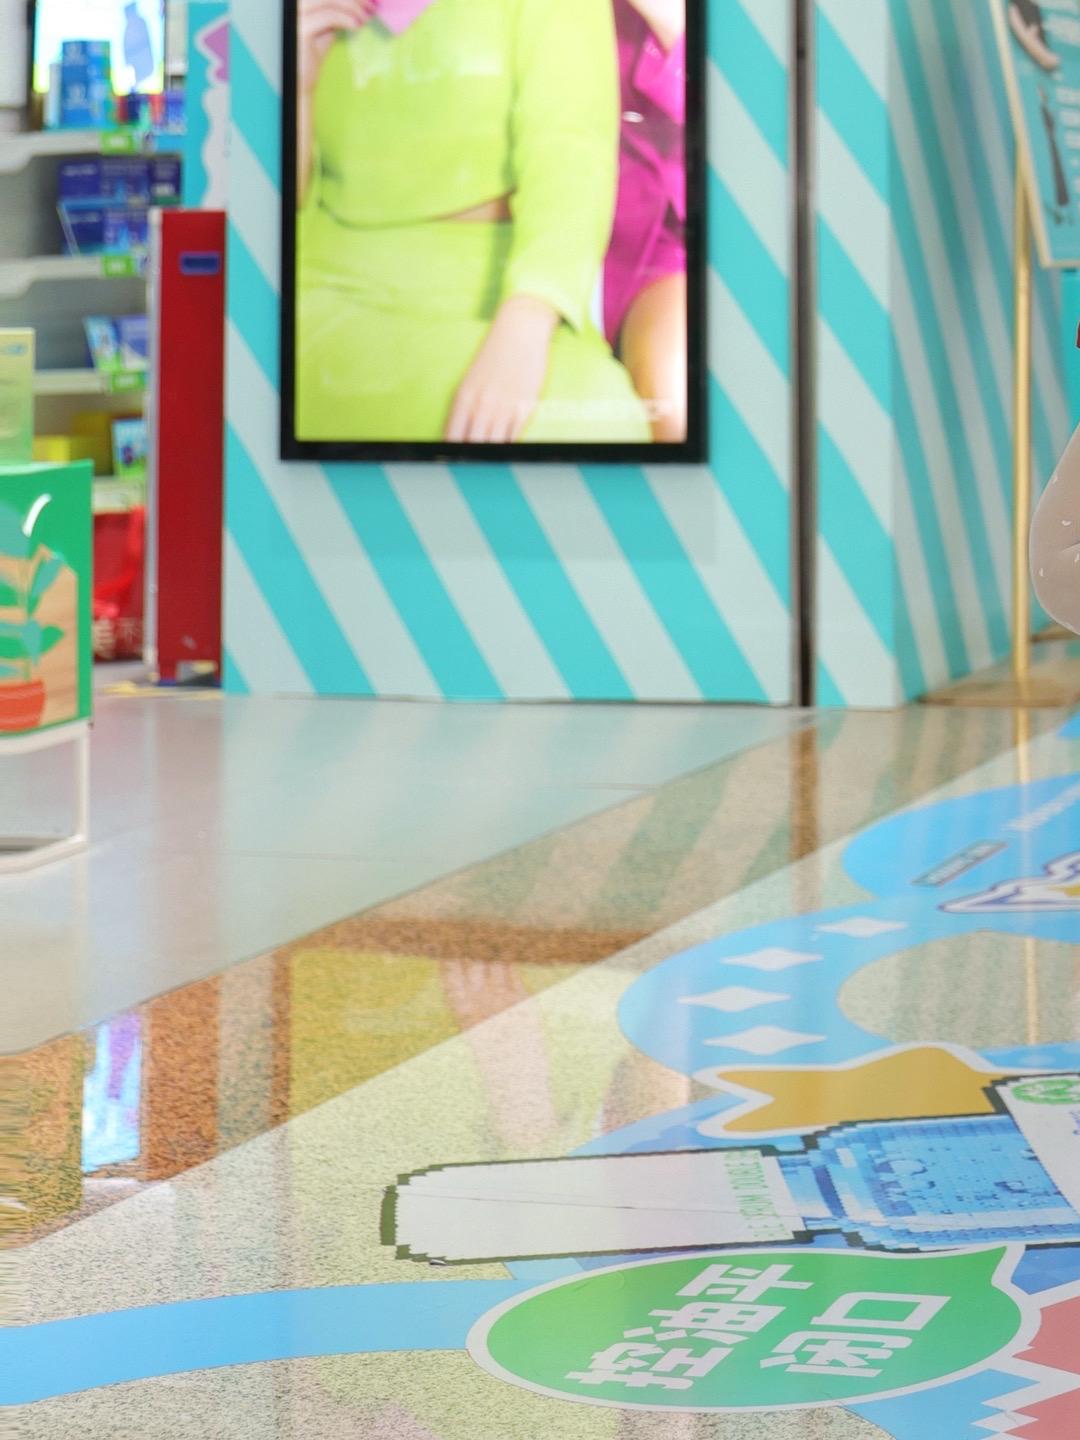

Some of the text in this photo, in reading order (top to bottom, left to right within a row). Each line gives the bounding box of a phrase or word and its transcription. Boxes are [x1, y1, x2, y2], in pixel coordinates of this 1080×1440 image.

[565, 1263, 814, 1390] 控油平
[759, 1291, 952, 1377] 闭口
